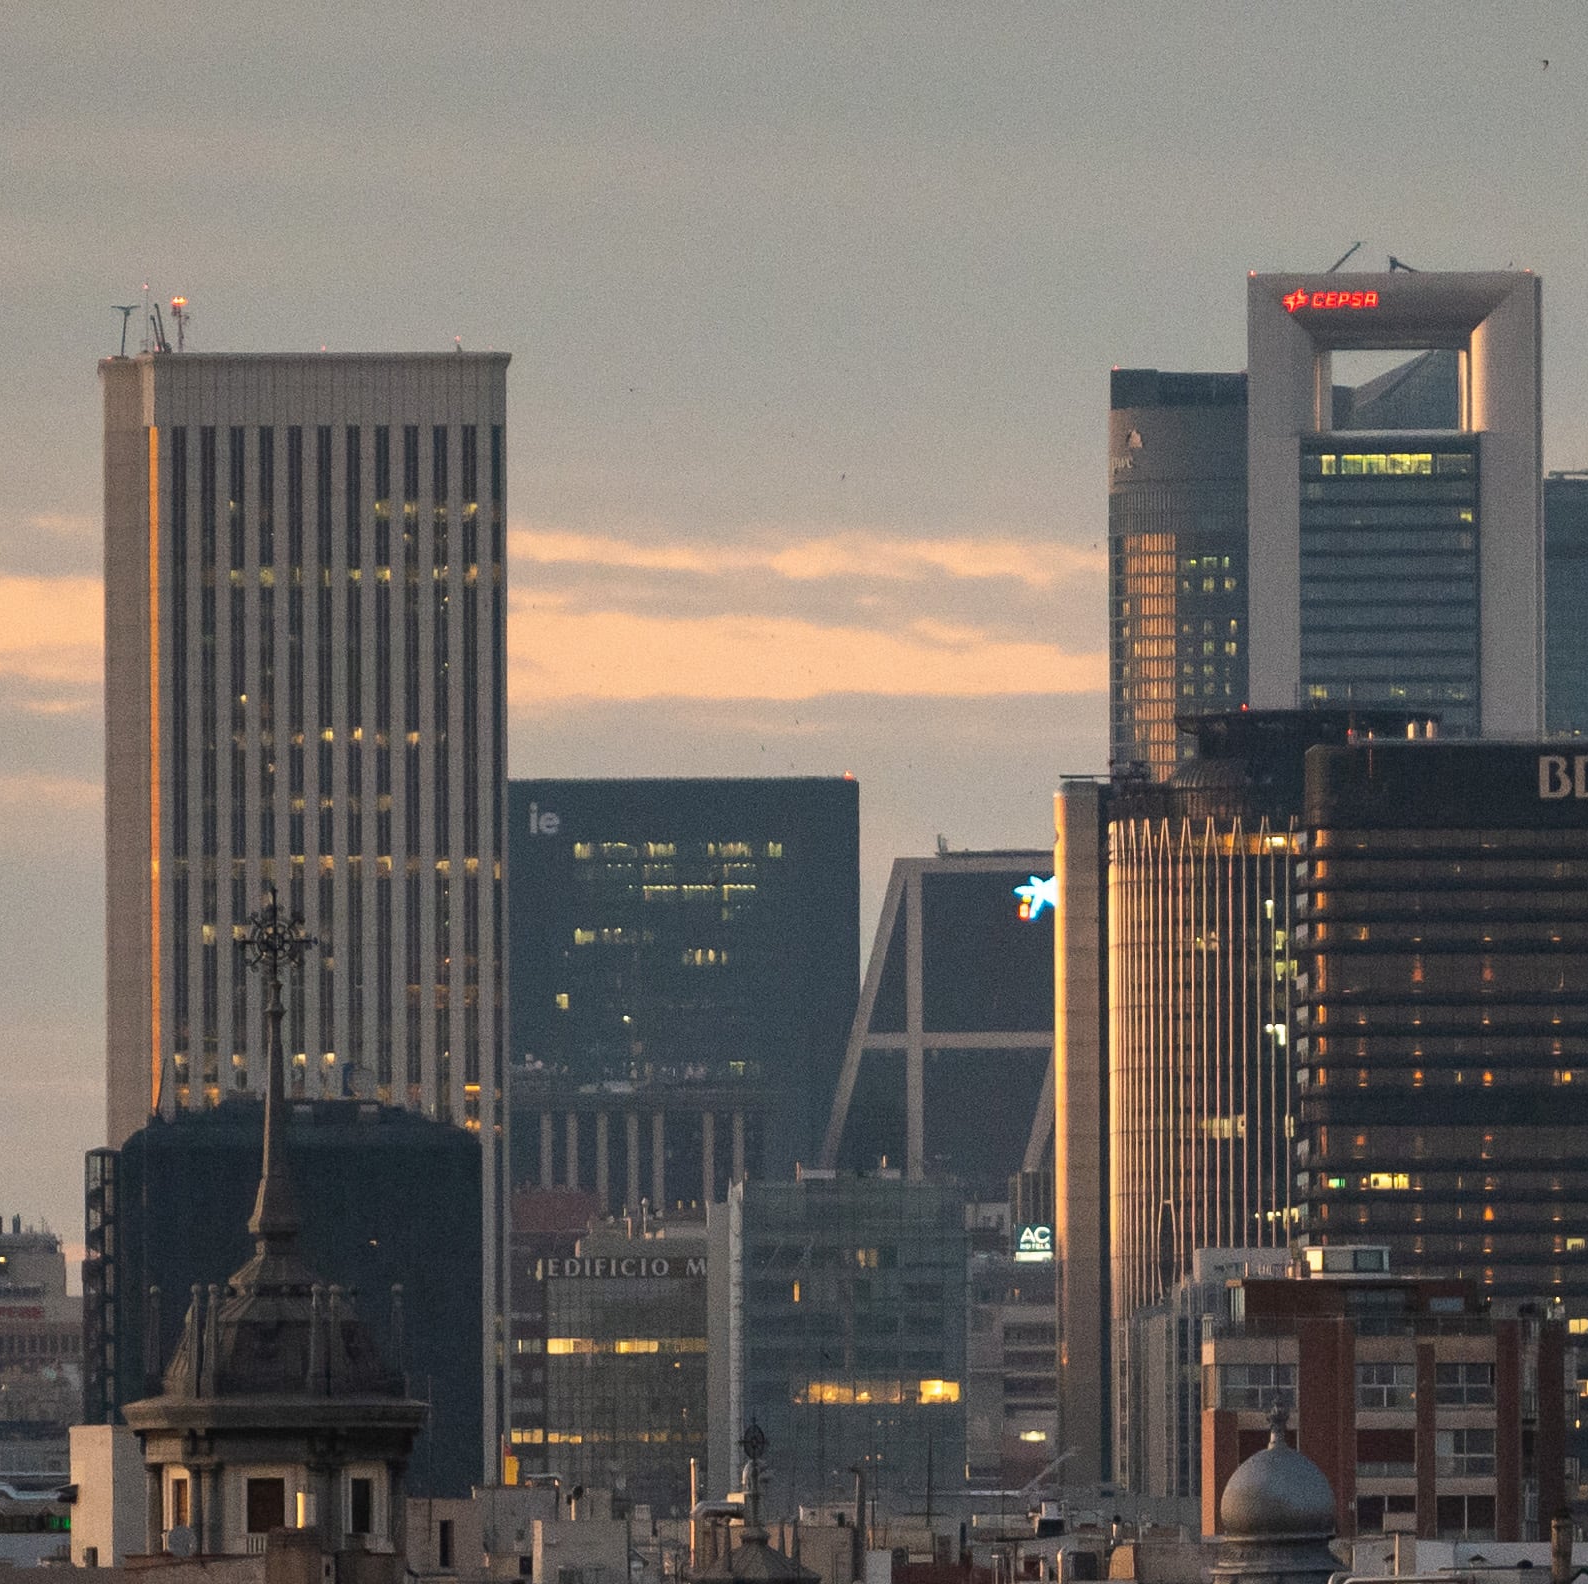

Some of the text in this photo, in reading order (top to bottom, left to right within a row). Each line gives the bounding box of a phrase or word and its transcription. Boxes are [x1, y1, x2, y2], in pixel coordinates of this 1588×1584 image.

[1313, 291, 1379, 309] CEPSA
[529, 800, 560, 835] ie
[1020, 1226, 1050, 1244] AC
[548, 1257, 670, 1277] EDIFICIO
